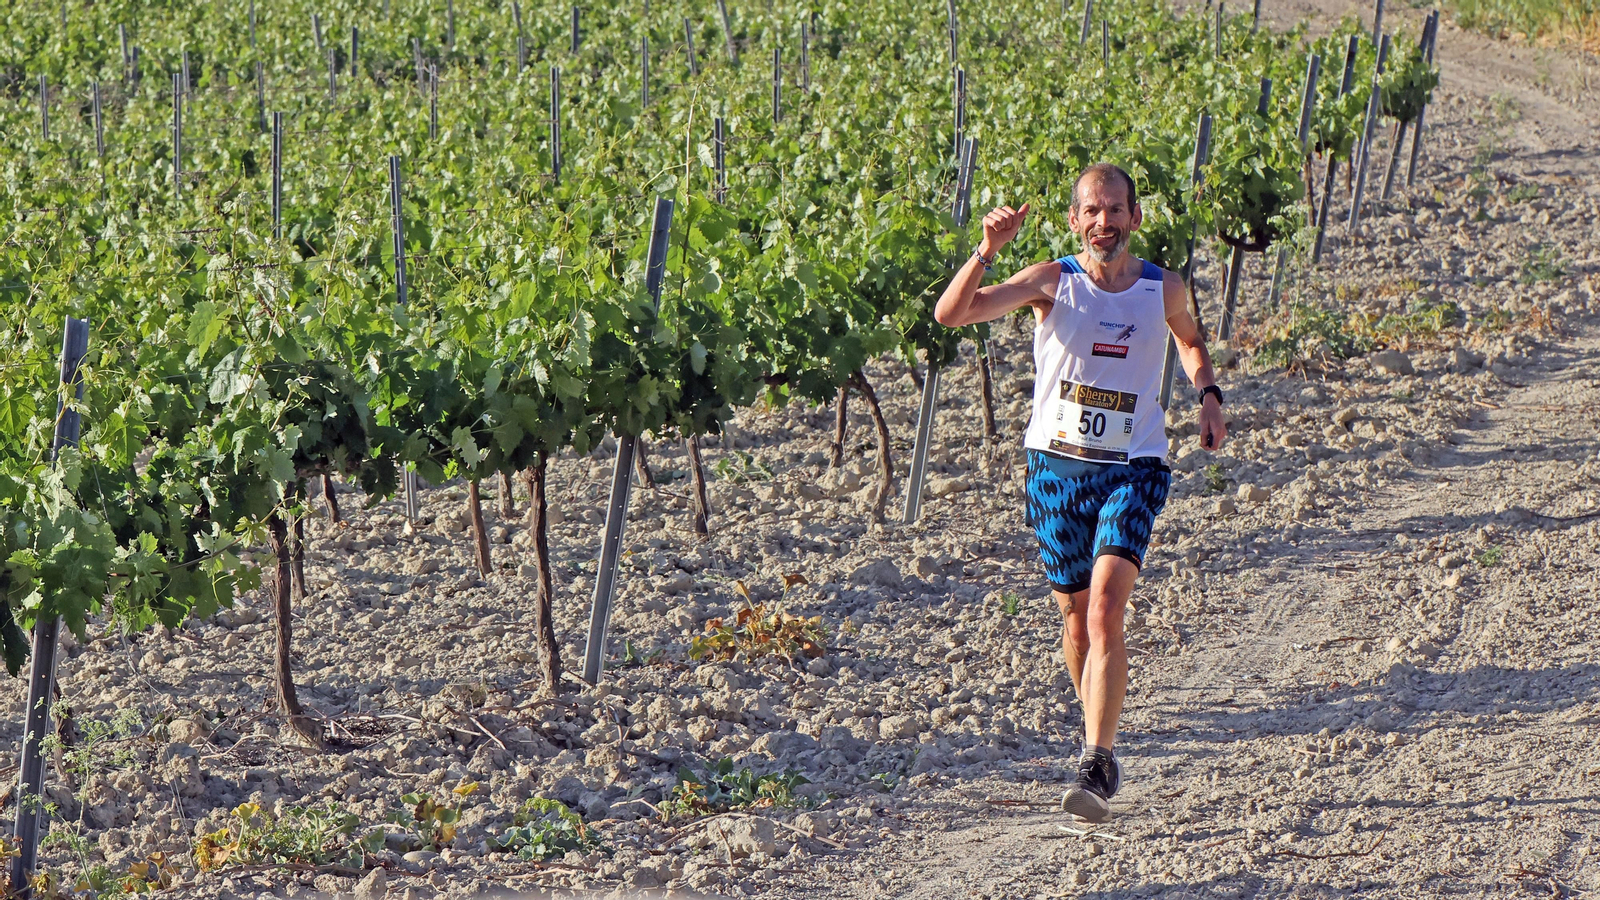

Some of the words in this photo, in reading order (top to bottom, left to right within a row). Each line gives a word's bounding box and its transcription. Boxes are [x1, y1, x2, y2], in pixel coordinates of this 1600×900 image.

[1099, 321, 1126, 329] RUNCHIP
[1079, 386, 1118, 407] Sherry
[1078, 410, 1107, 437] 50
